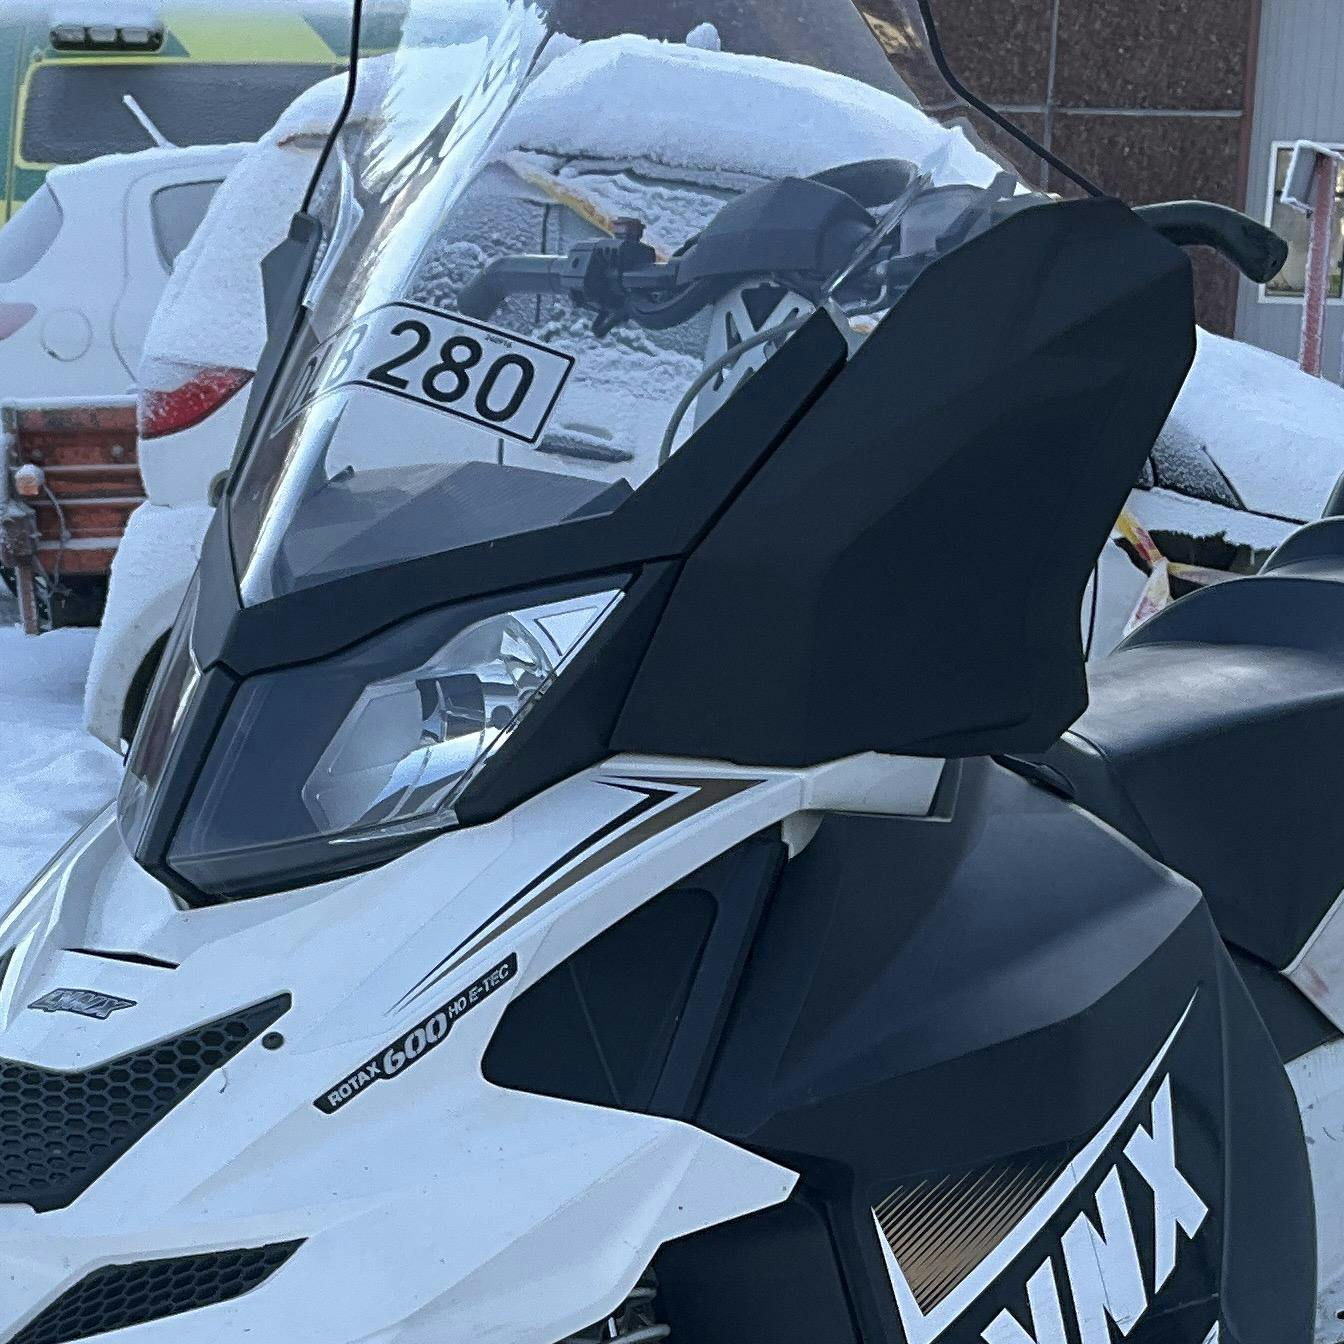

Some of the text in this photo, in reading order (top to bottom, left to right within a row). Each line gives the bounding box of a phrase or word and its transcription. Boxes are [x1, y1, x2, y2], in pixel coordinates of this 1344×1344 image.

[366, 319, 535, 423] 280
[327, 963, 510, 1107] ROTAX 600 HO E-TEC
